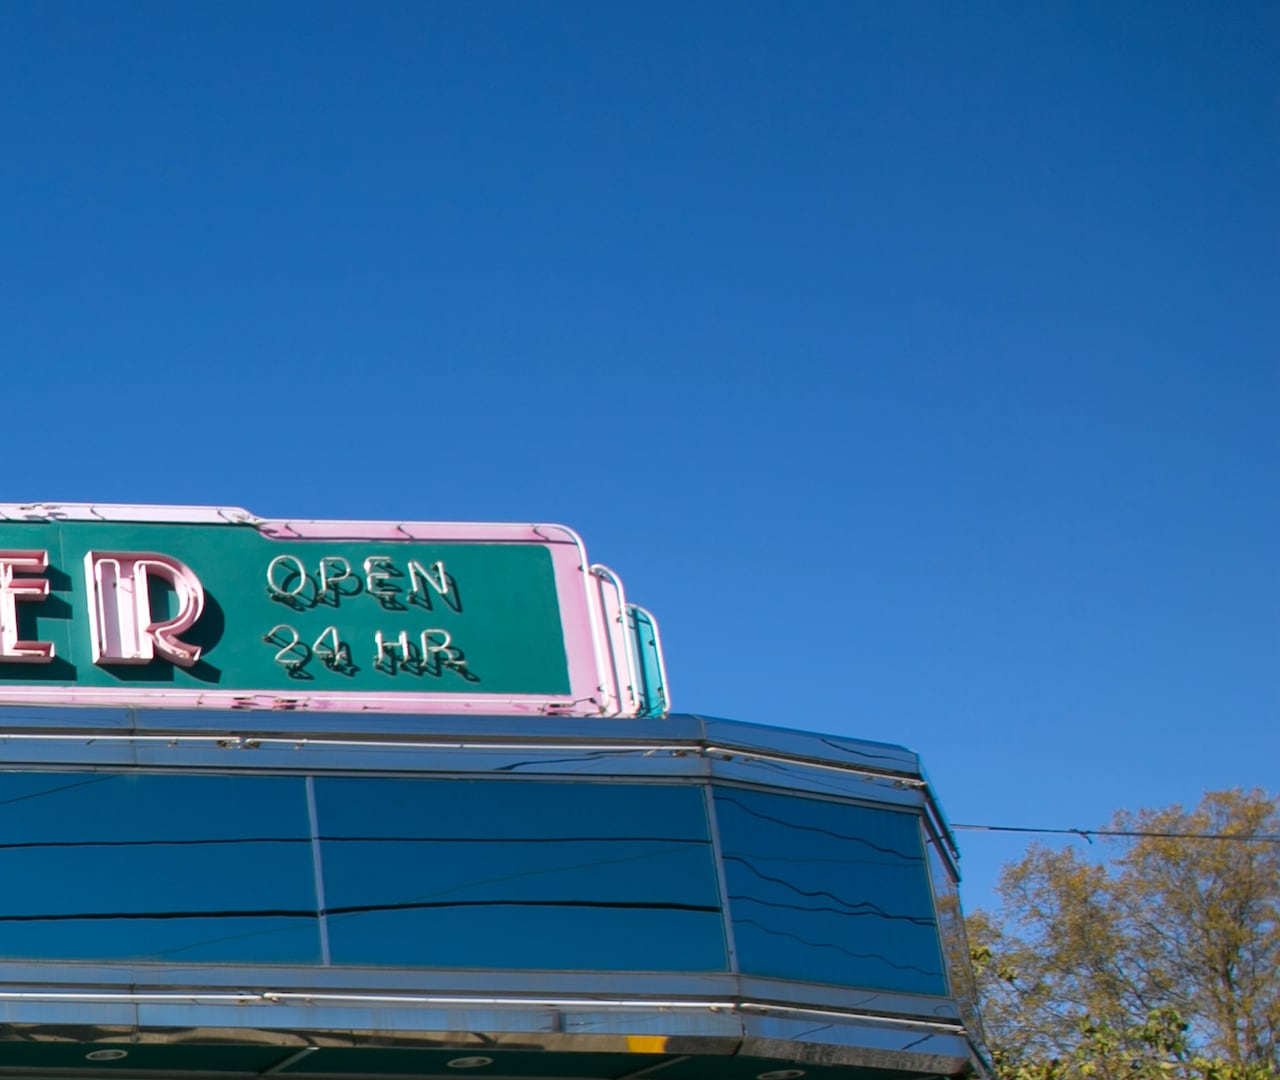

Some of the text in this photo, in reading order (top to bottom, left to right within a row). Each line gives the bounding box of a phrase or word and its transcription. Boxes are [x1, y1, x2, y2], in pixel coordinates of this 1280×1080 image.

[267, 554, 449, 596] OPEN
[264, 624, 467, 668] 24 HR
